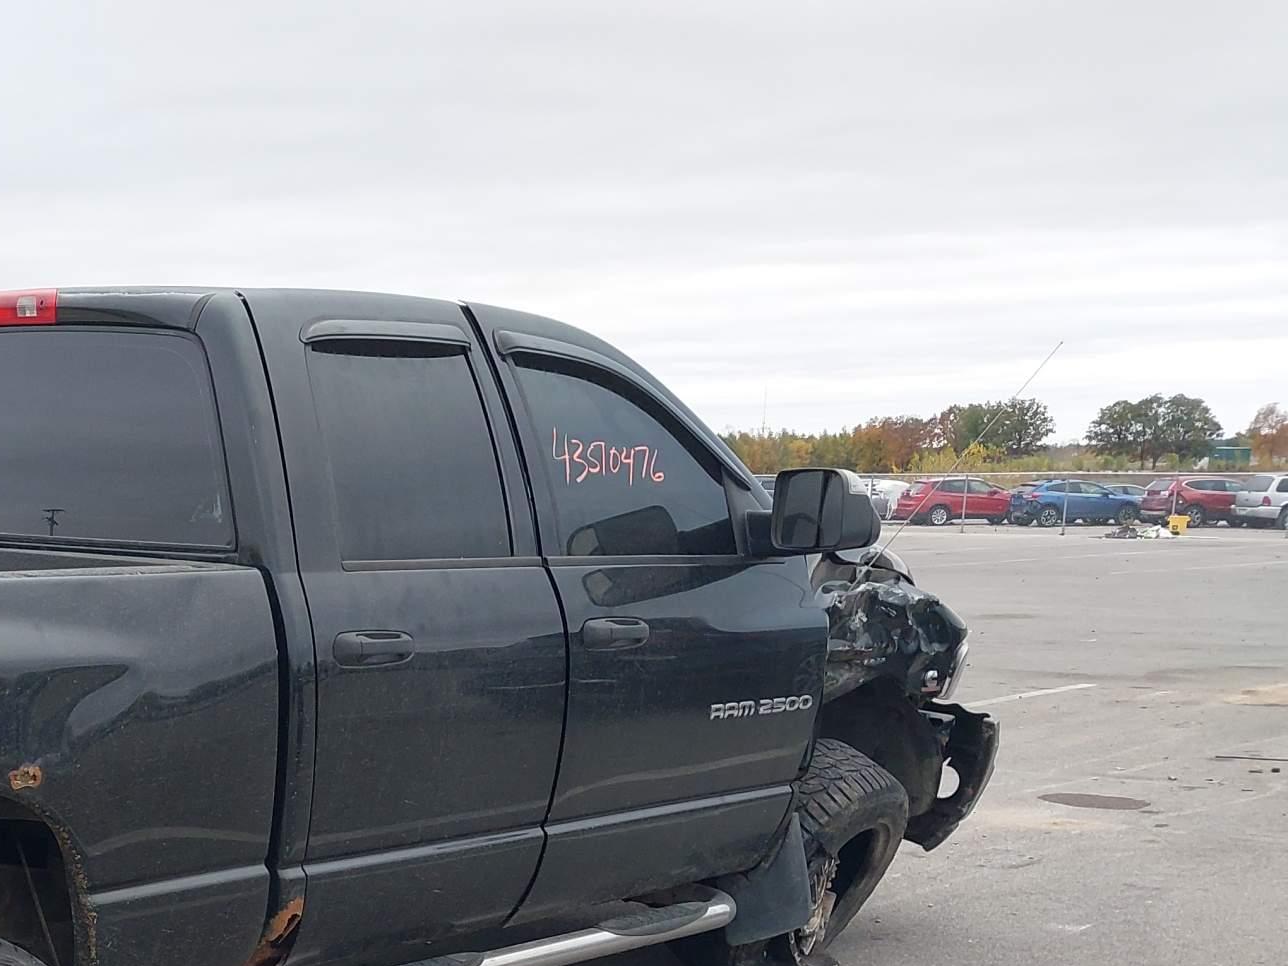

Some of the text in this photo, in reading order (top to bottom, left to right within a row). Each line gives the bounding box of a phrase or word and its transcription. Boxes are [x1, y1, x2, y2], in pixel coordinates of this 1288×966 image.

[552, 425, 665, 487] 43510476
[710, 695, 813, 720] RAM 2500
